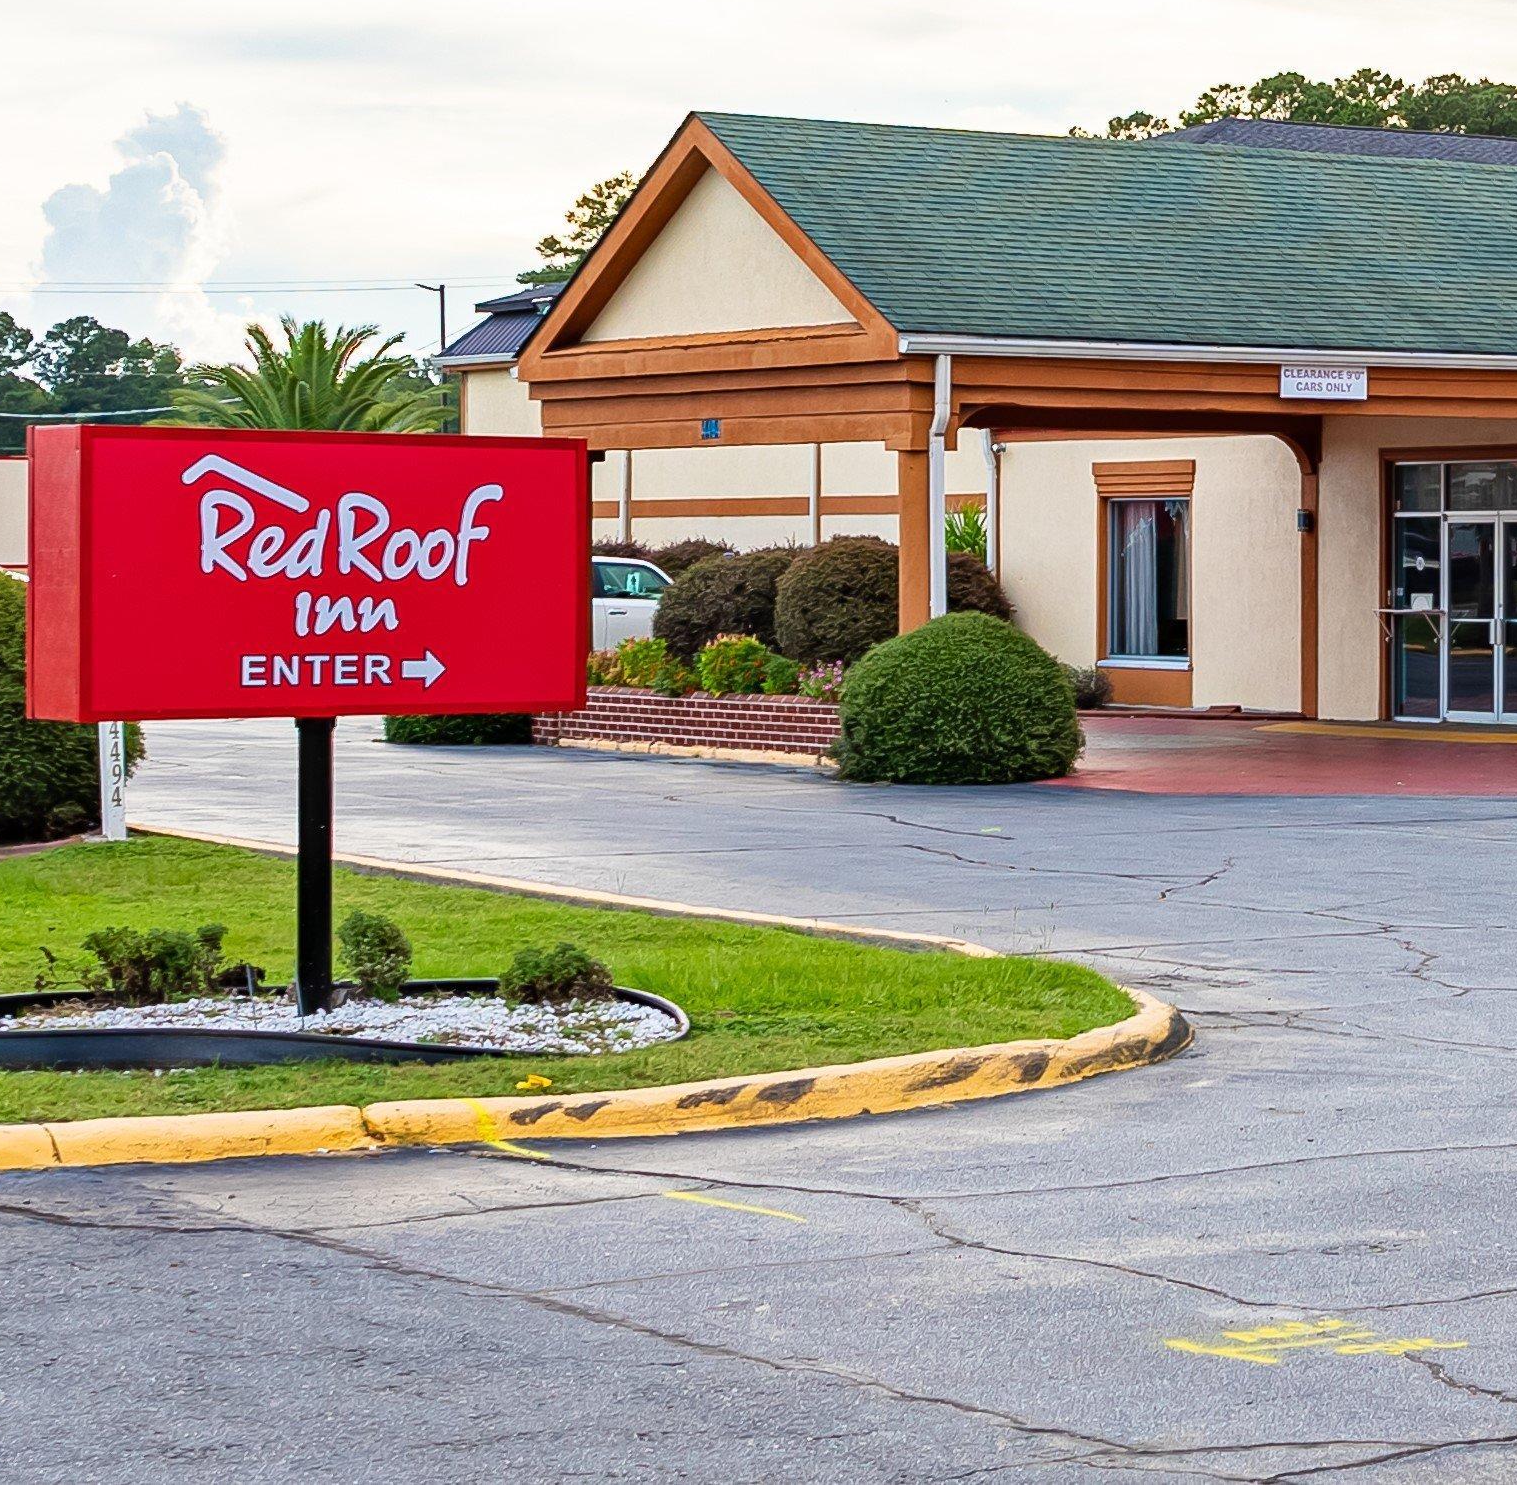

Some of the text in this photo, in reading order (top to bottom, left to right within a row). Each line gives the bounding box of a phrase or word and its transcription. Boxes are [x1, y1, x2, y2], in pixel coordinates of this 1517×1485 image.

[1283, 368, 1343, 380] CLEARANCE
[1295, 382, 1352, 393] CARS ONLY
[199, 484, 504, 586] Red Roof
[241, 655, 392, 688] ENTER
[109, 721, 122, 807] 4494
